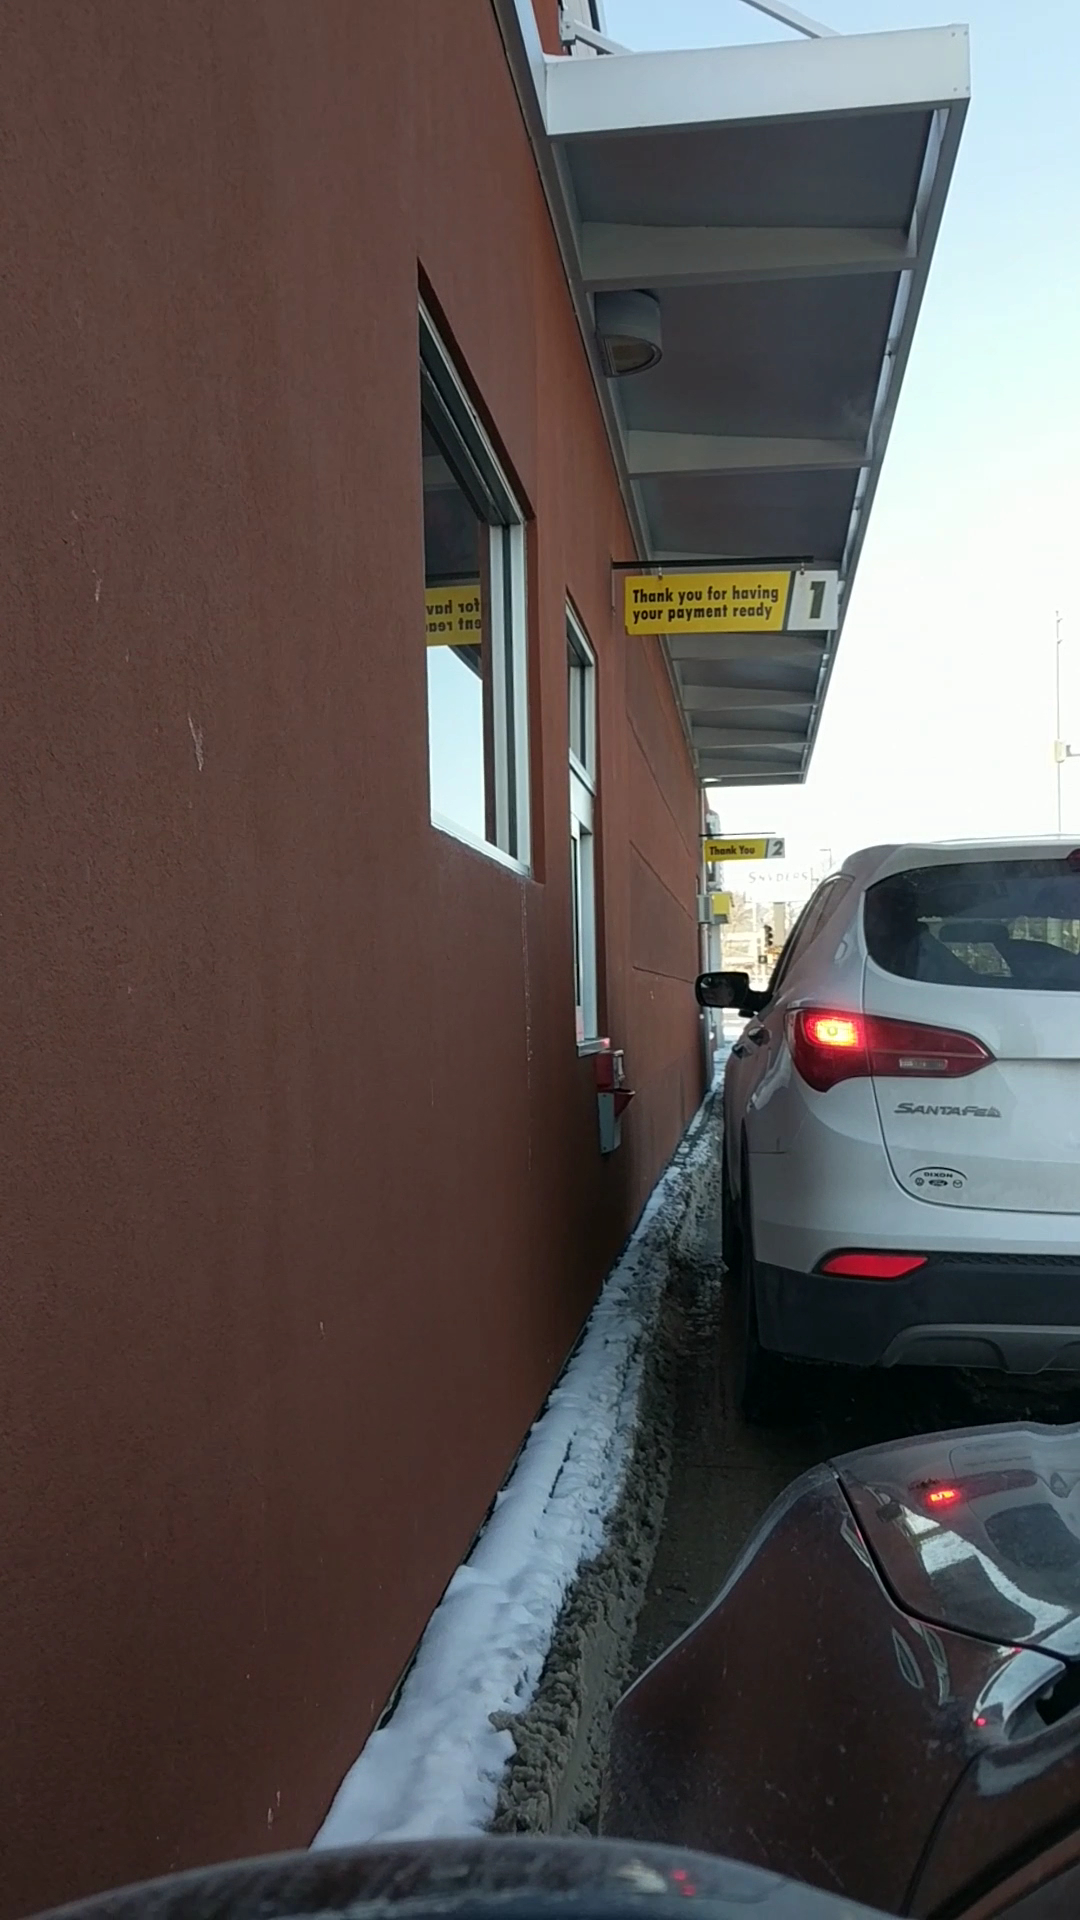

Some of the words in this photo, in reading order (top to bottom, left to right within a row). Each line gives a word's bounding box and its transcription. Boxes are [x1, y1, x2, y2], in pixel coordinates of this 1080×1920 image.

[632, 588, 673, 604] Thank
[678, 588, 702, 605] you
[707, 586, 727, 601] for
[732, 584, 779, 603] having
[809, 581, 826, 619] 1
[633, 607, 663, 624] your
[668, 605, 728, 622] payment
[732, 603, 773, 620] ready
[709, 845, 737, 856] Thank
[739, 845, 755, 855] You
[772, 841, 783, 856] 2
[923, 1171, 954, 1179] DIXON
